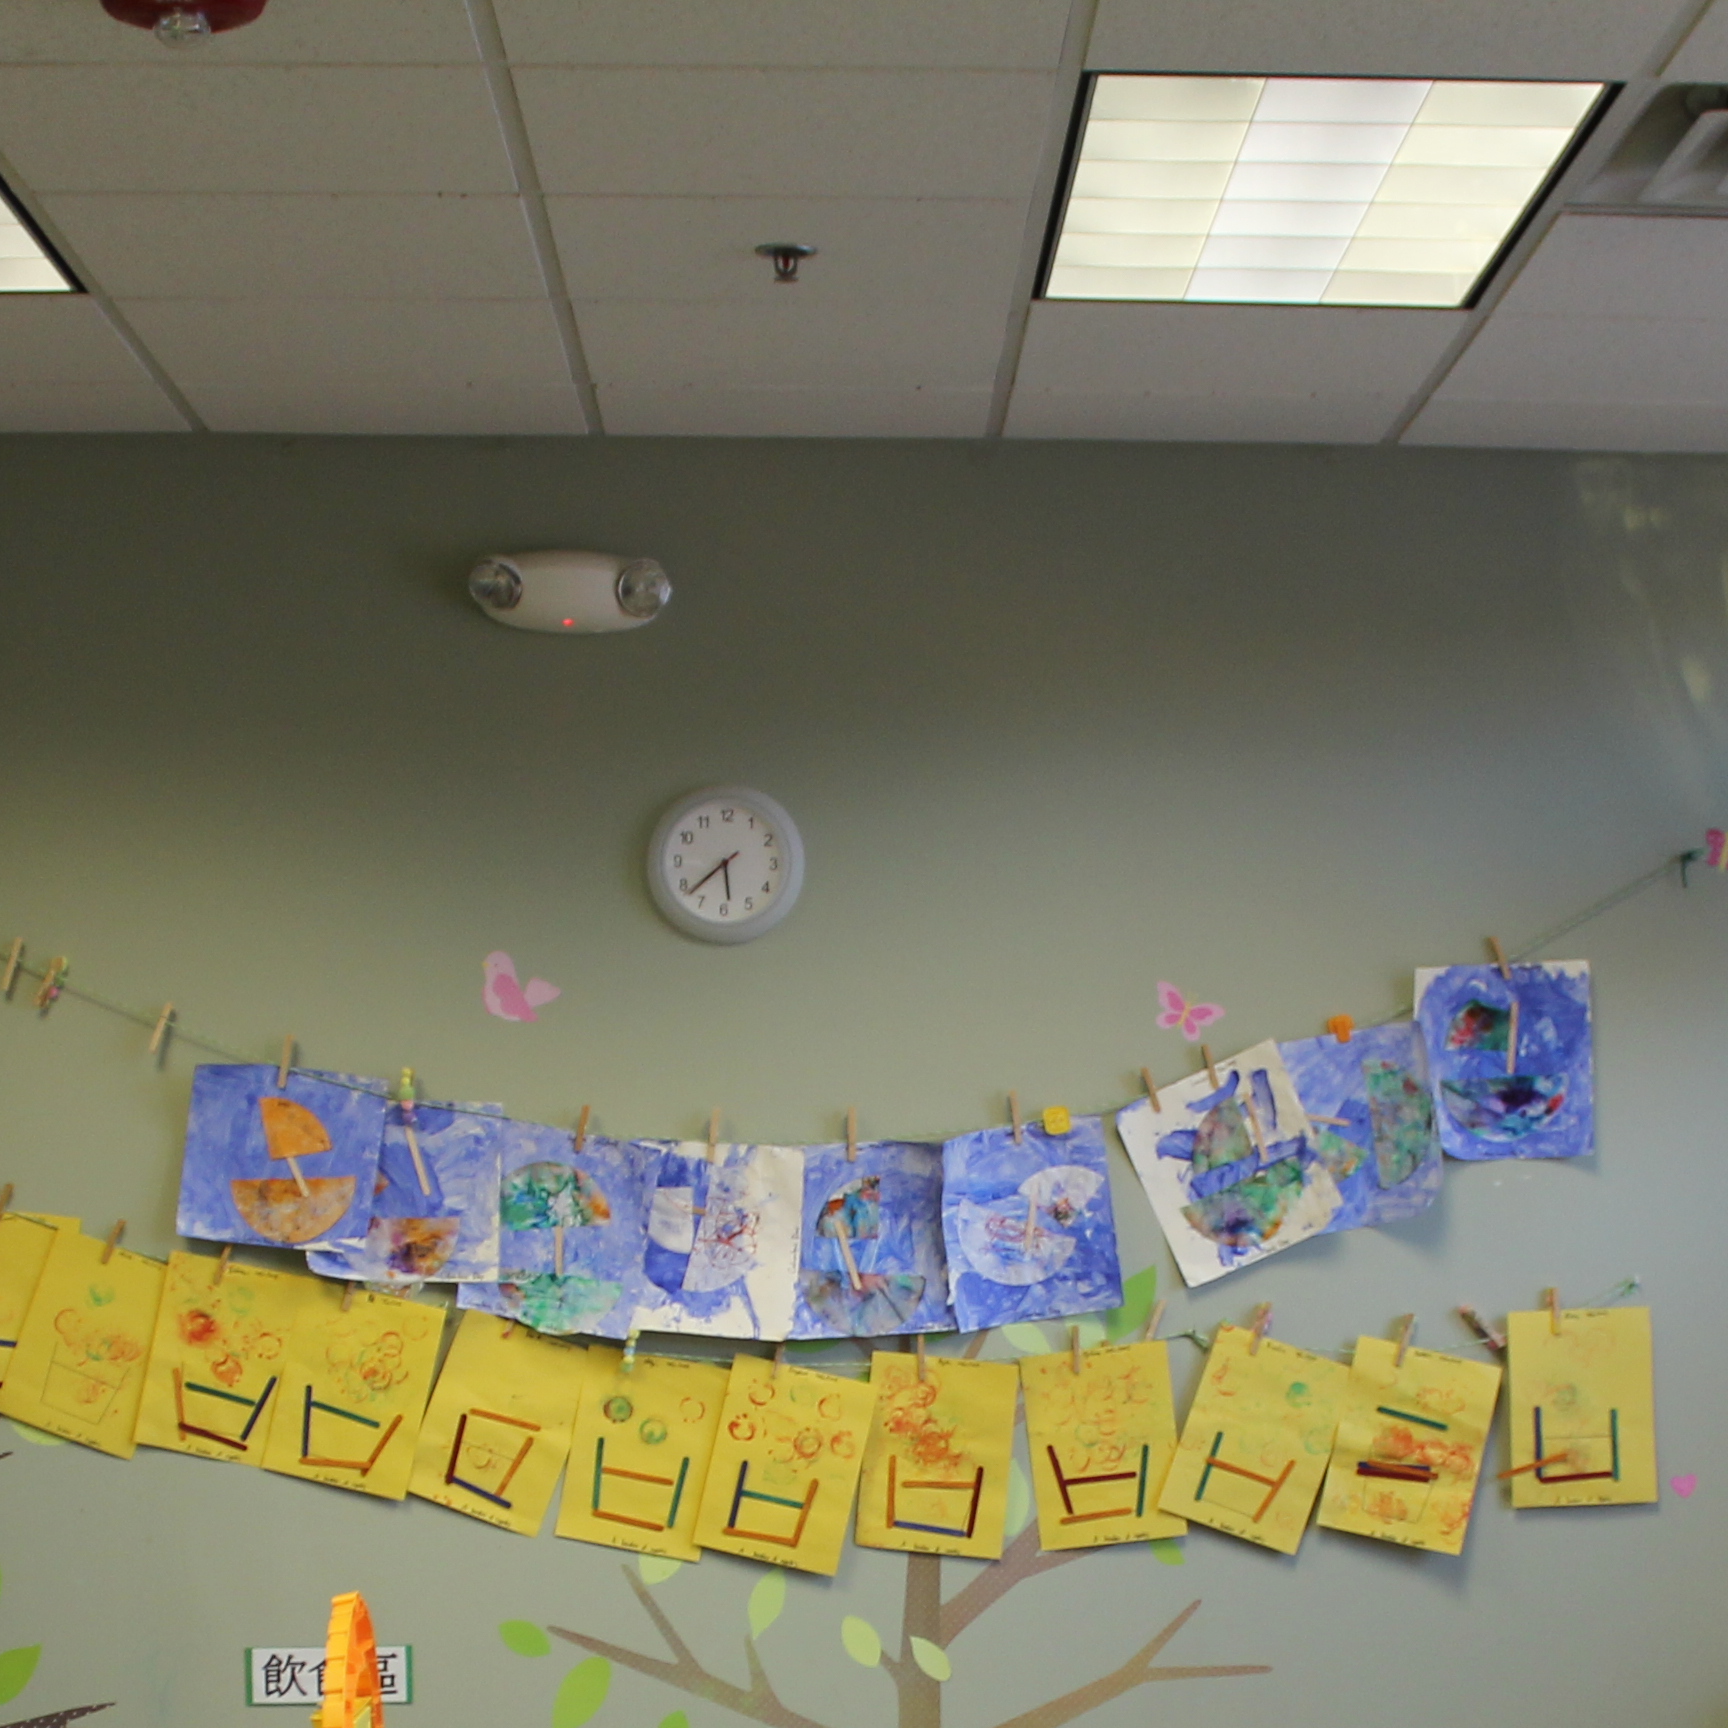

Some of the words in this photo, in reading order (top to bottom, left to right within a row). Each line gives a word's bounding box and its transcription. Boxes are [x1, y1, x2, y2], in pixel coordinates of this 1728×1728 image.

[721, 809, 734, 822] 12
[697, 816, 709, 828] 11
[749, 817, 754, 829] 1
[681, 832, 693, 844] 10
[764, 834, 773, 846] 2
[674, 856, 682, 868] 9
[770, 857, 777, 870] 3
[680, 879, 688, 891] 8
[762, 881, 769, 893] 4
[698, 896, 705, 908] 7
[745, 897, 753, 910] 5
[720, 903, 727, 916] 6
